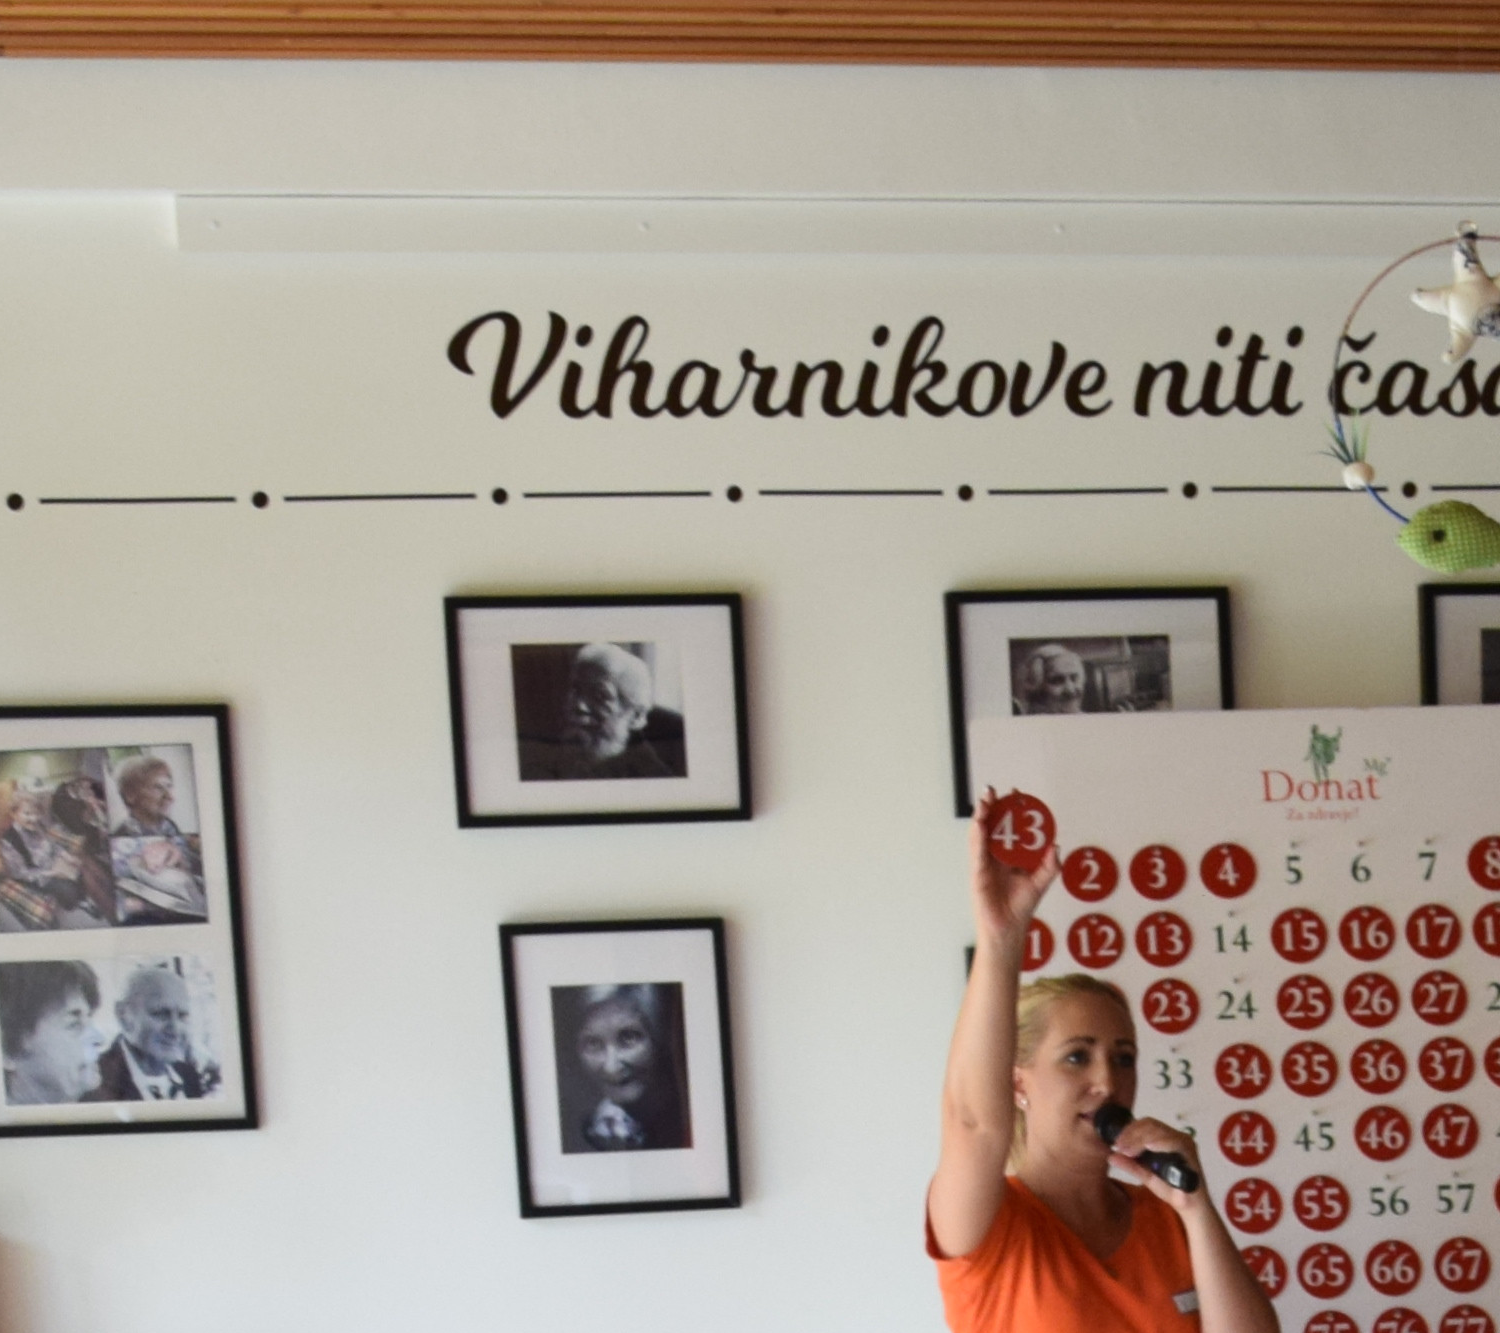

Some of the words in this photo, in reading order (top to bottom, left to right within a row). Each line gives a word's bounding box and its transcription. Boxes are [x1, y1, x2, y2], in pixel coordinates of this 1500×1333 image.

[447, 311, 1113, 419] Viharnikove
[1133, 326, 1304, 417] niti
[1261, 769, 1381, 802] Donat
[991, 809, 1046, 851] 43
[1080, 858, 1101, 890] 2
[1148, 856, 1167, 889] 3
[1218, 856, 1239, 886] 4
[1286, 855, 1303, 885] 5
[1350, 857, 1372, 882] 6
[1418, 851, 1437, 881] 7
[1077, 925, 1117, 958] 12
[1146, 923, 1184, 955] 13
[1215, 925, 1251, 953] 14
[1282, 920, 1320, 952] 15
[1349, 919, 1389, 949] 16
[1416, 916, 1454, 947] 17
[1151, 989, 1192, 1024] 23
[1218, 990, 1257, 1020] 24
[1285, 986, 1326, 1018] 25
[1352, 984, 1393, 1016] 26
[1420, 982, 1459, 1014] 27
[1155, 1058, 1194, 1089] 33
[1223, 1056, 1265, 1088] 34
[1289, 1053, 1330, 1085] 35
[1358, 1052, 1401, 1083] 36
[1427, 1048, 1465, 1081] 37
[1224, 1124, 1269, 1155] 44
[1295, 1121, 1335, 1152] 45
[1360, 1119, 1405, 1150] 46
[1429, 1115, 1470, 1147] 47
[1234, 1191, 1276, 1223] 54
[1302, 1187, 1343, 1220] 55
[1370, 1187, 1410, 1217] 56
[1437, 1183, 1475, 1214] 57
[1303, 1255, 1346, 1287] 65
[1371, 1254, 1415, 1284] 66
[1440, 1249, 1482, 1281] 67
